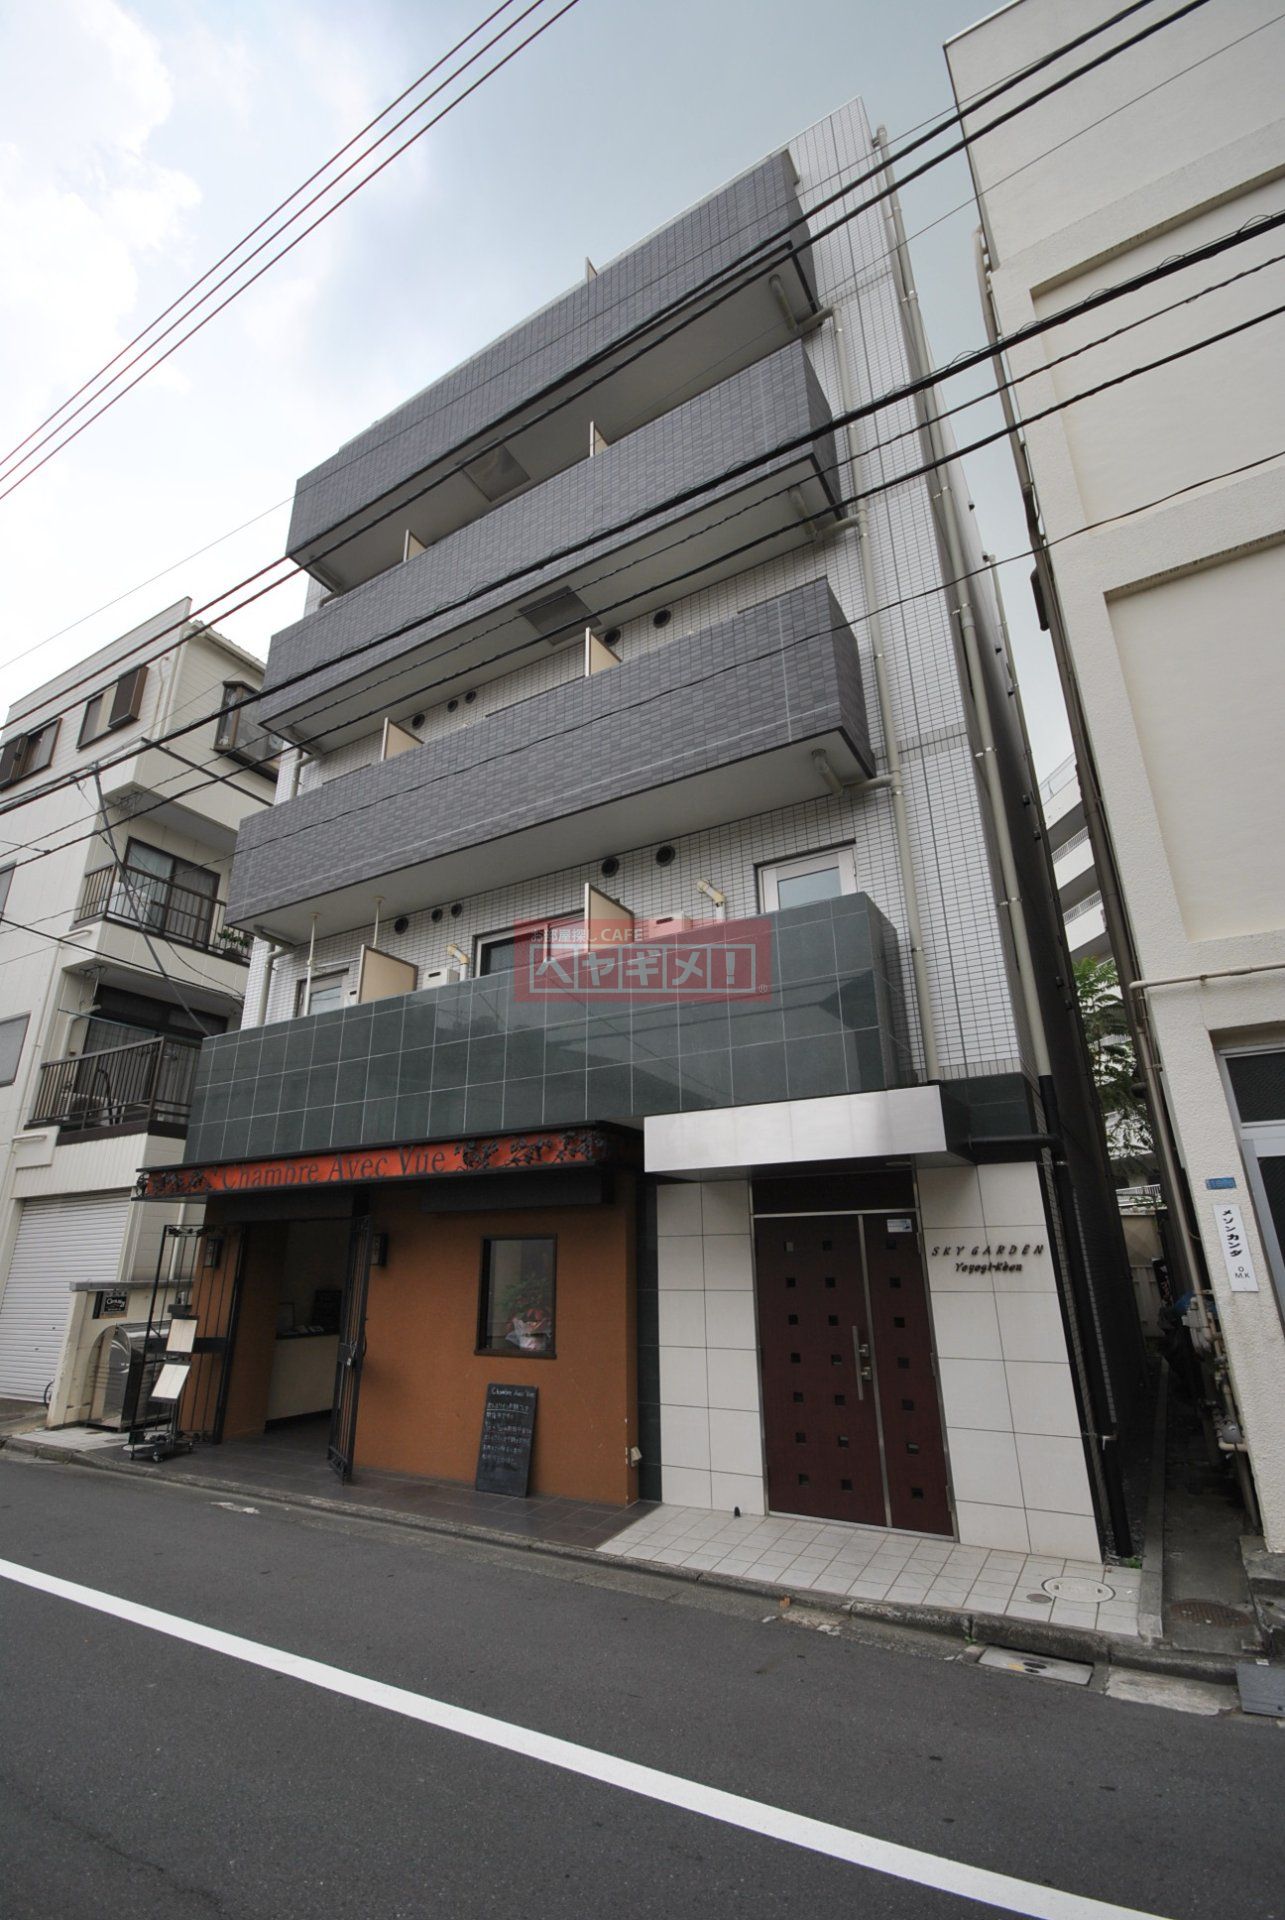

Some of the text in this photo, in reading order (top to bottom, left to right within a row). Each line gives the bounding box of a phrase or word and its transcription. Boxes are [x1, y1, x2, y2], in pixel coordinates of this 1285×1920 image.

[222, 1145, 445, 1189] Chambre Avec Vue
[931, 1244, 1044, 1257] SKY GARDEN
